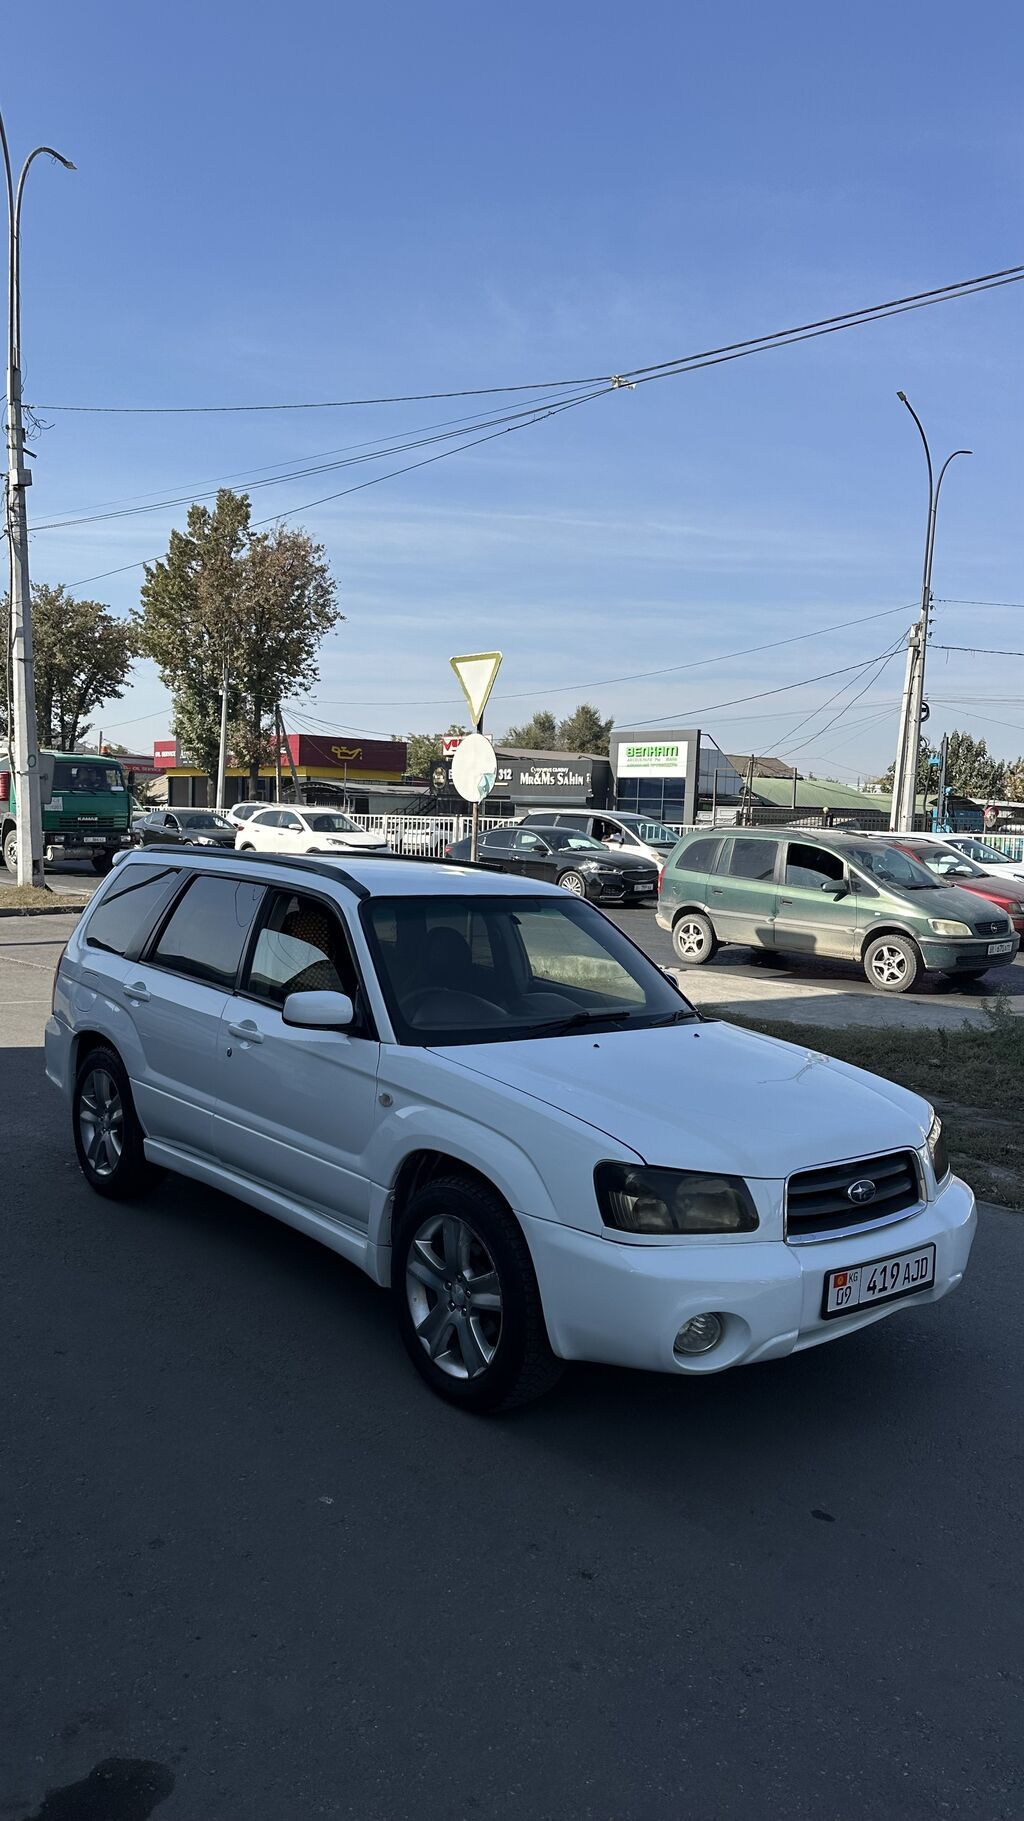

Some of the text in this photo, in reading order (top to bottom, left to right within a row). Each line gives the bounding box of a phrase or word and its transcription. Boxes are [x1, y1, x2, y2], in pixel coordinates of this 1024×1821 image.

[498, 768, 512, 780] 312
[848, 1271, 859, 1283] KG
[867, 1256, 929, 1296] 419 AJD
[836, 1286, 852, 1306] 09
